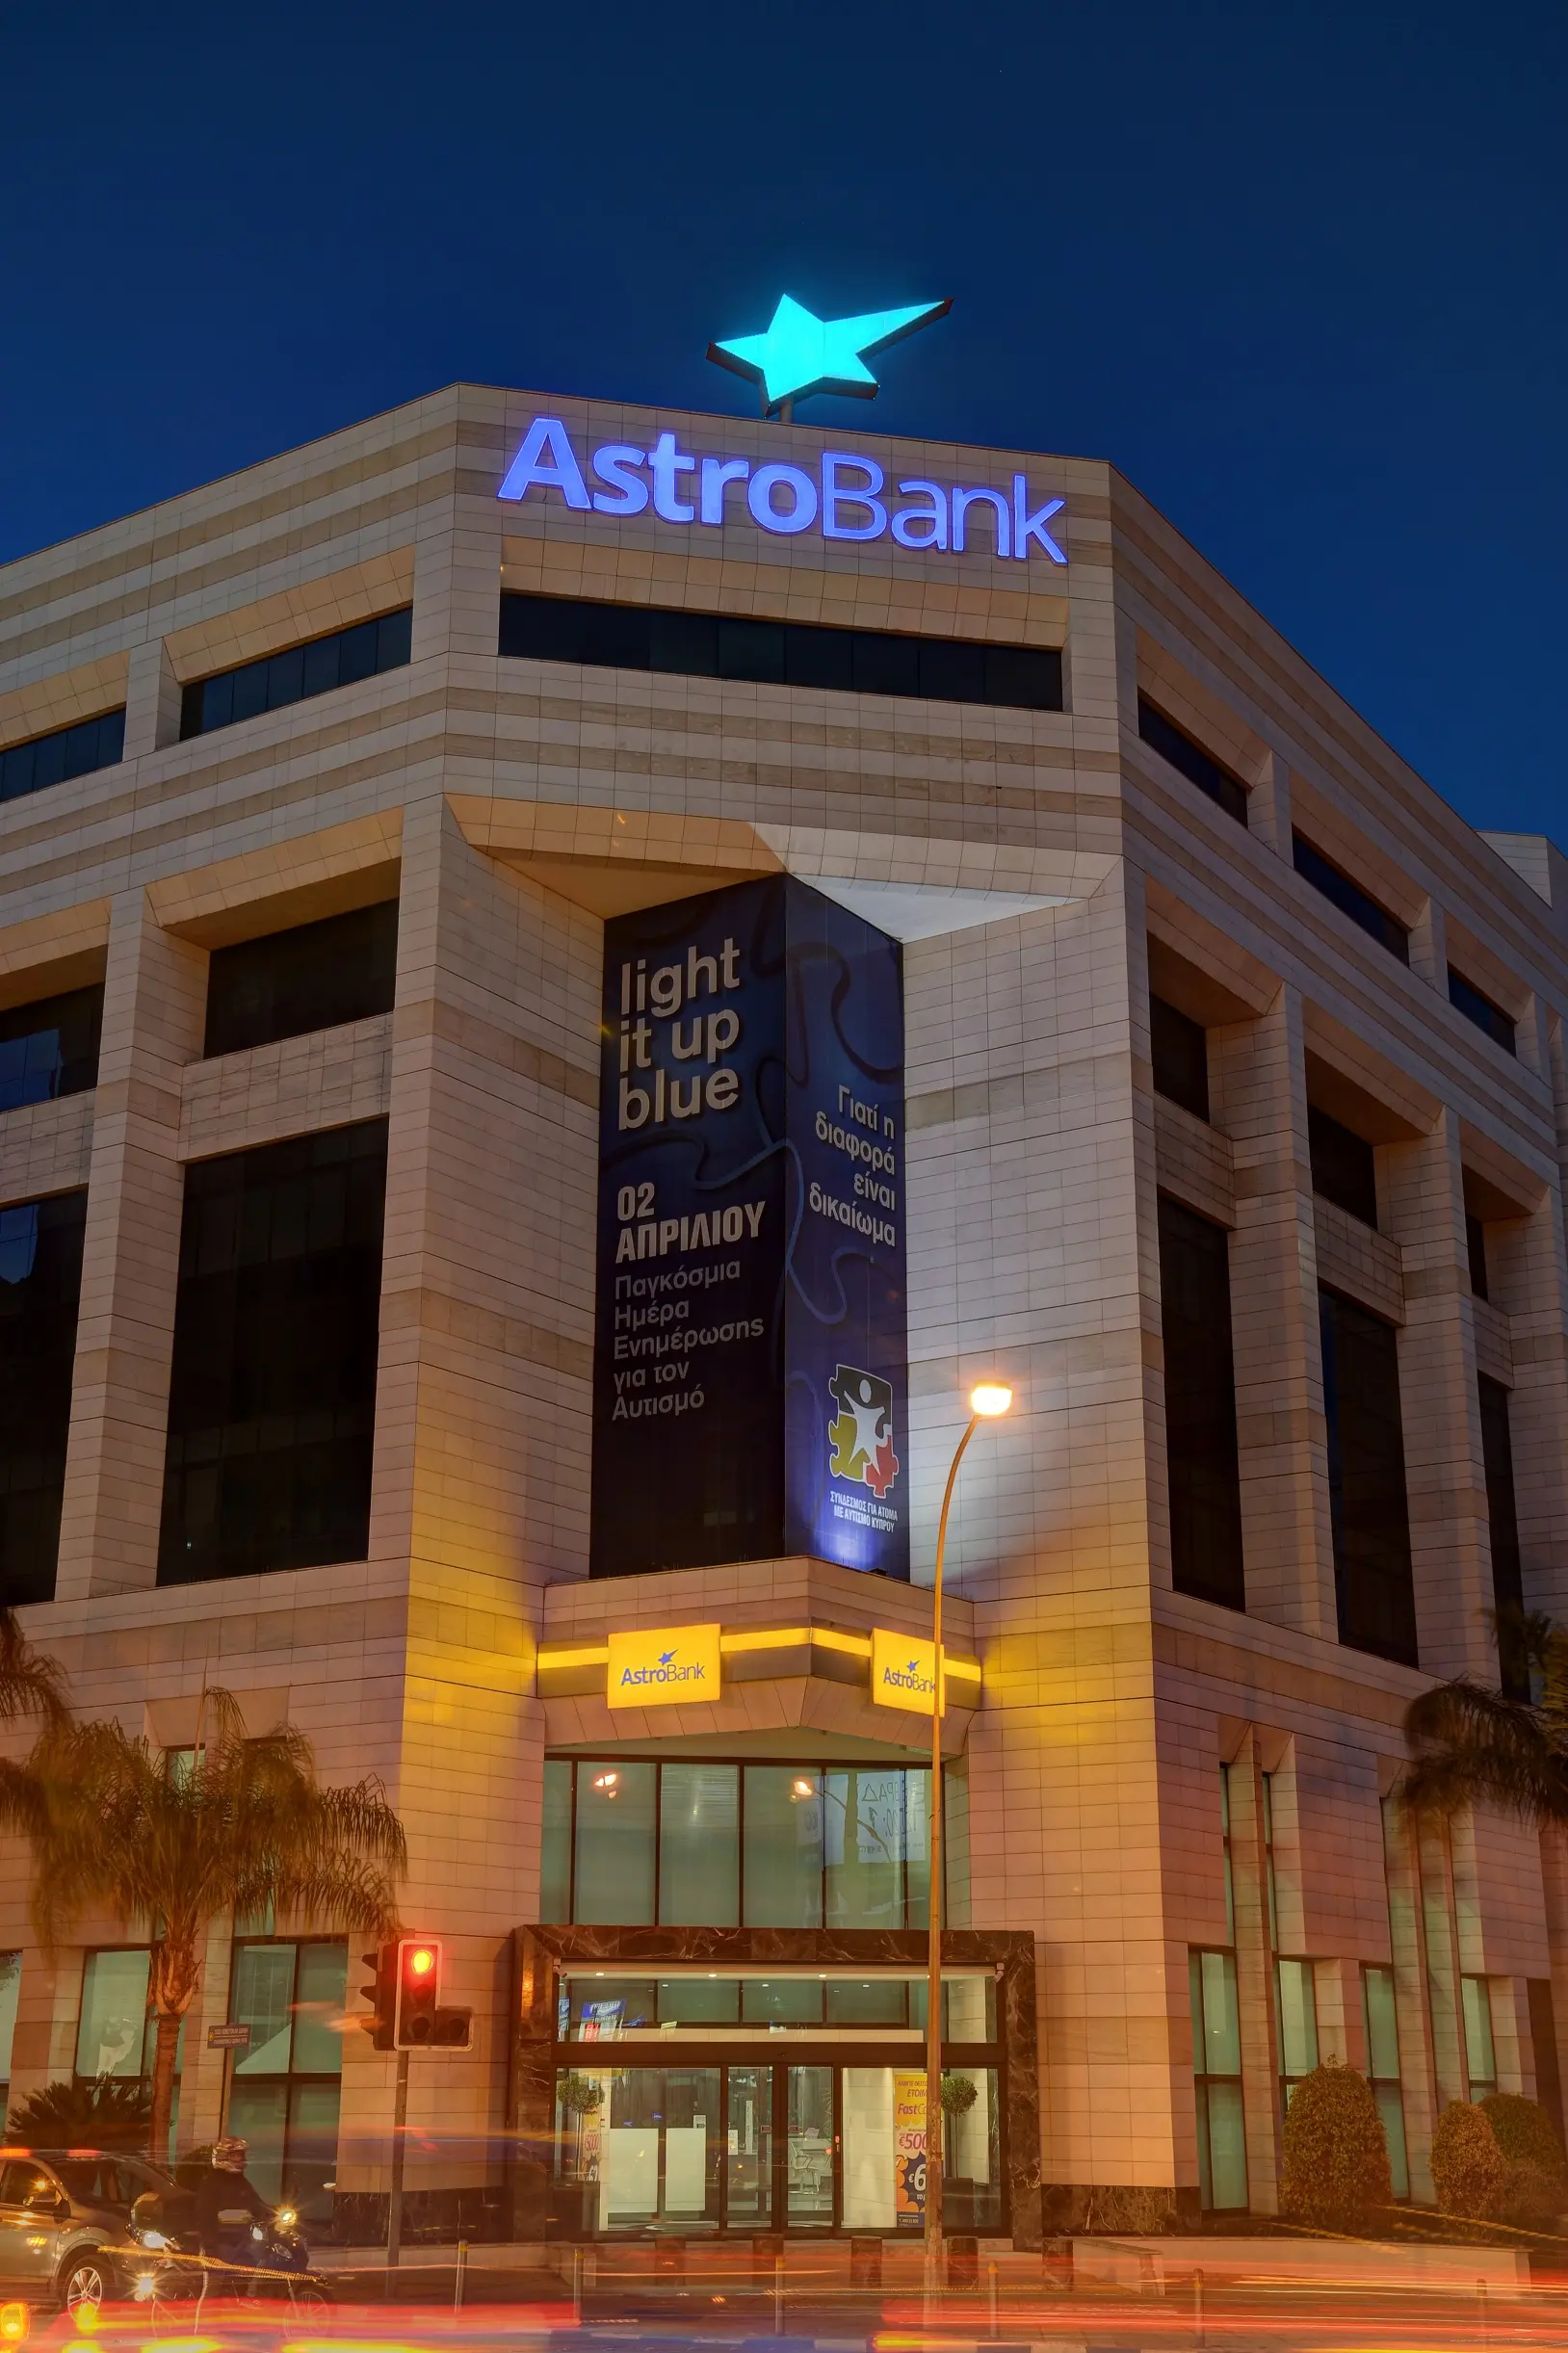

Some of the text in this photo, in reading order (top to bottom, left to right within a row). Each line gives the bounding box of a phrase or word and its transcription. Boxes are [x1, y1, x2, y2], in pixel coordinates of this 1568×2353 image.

[497, 417, 1070, 565] AstroBank
[621, 937, 740, 1018] light
[619, 1008, 740, 1073] it up
[618, 1067, 740, 1131] blue
[838, 1084, 895, 1140] Γιατί η
[815, 1111, 895, 1176] διαφορά
[617, 1182, 655, 1221] 02
[853, 1171, 896, 1211] είναι
[615, 1201, 766, 1264] ΑΠΡΙΛΙΟΥ
[809, 1182, 896, 1247] δικαίωμα
[614, 1260, 741, 1300] Παγκόσμια
[614, 1299, 690, 1332] Ημέρα
[614, 1317, 764, 1360] Ενημέρωσης
[614, 1361, 690, 1395] για τον
[612, 1384, 705, 1421] Αυτισμό
[829, 1490, 899, 1522] ΣΥΝΔΕΣΜΟΣ ΓΙΑ ΑΤΟΜΑ
[833, 1504, 895, 1533] ΜΕ ΑΥΤΙΣΜΟ ΚΥΠΡΟΥ
[620, 1661, 706, 1686] AstroBank
